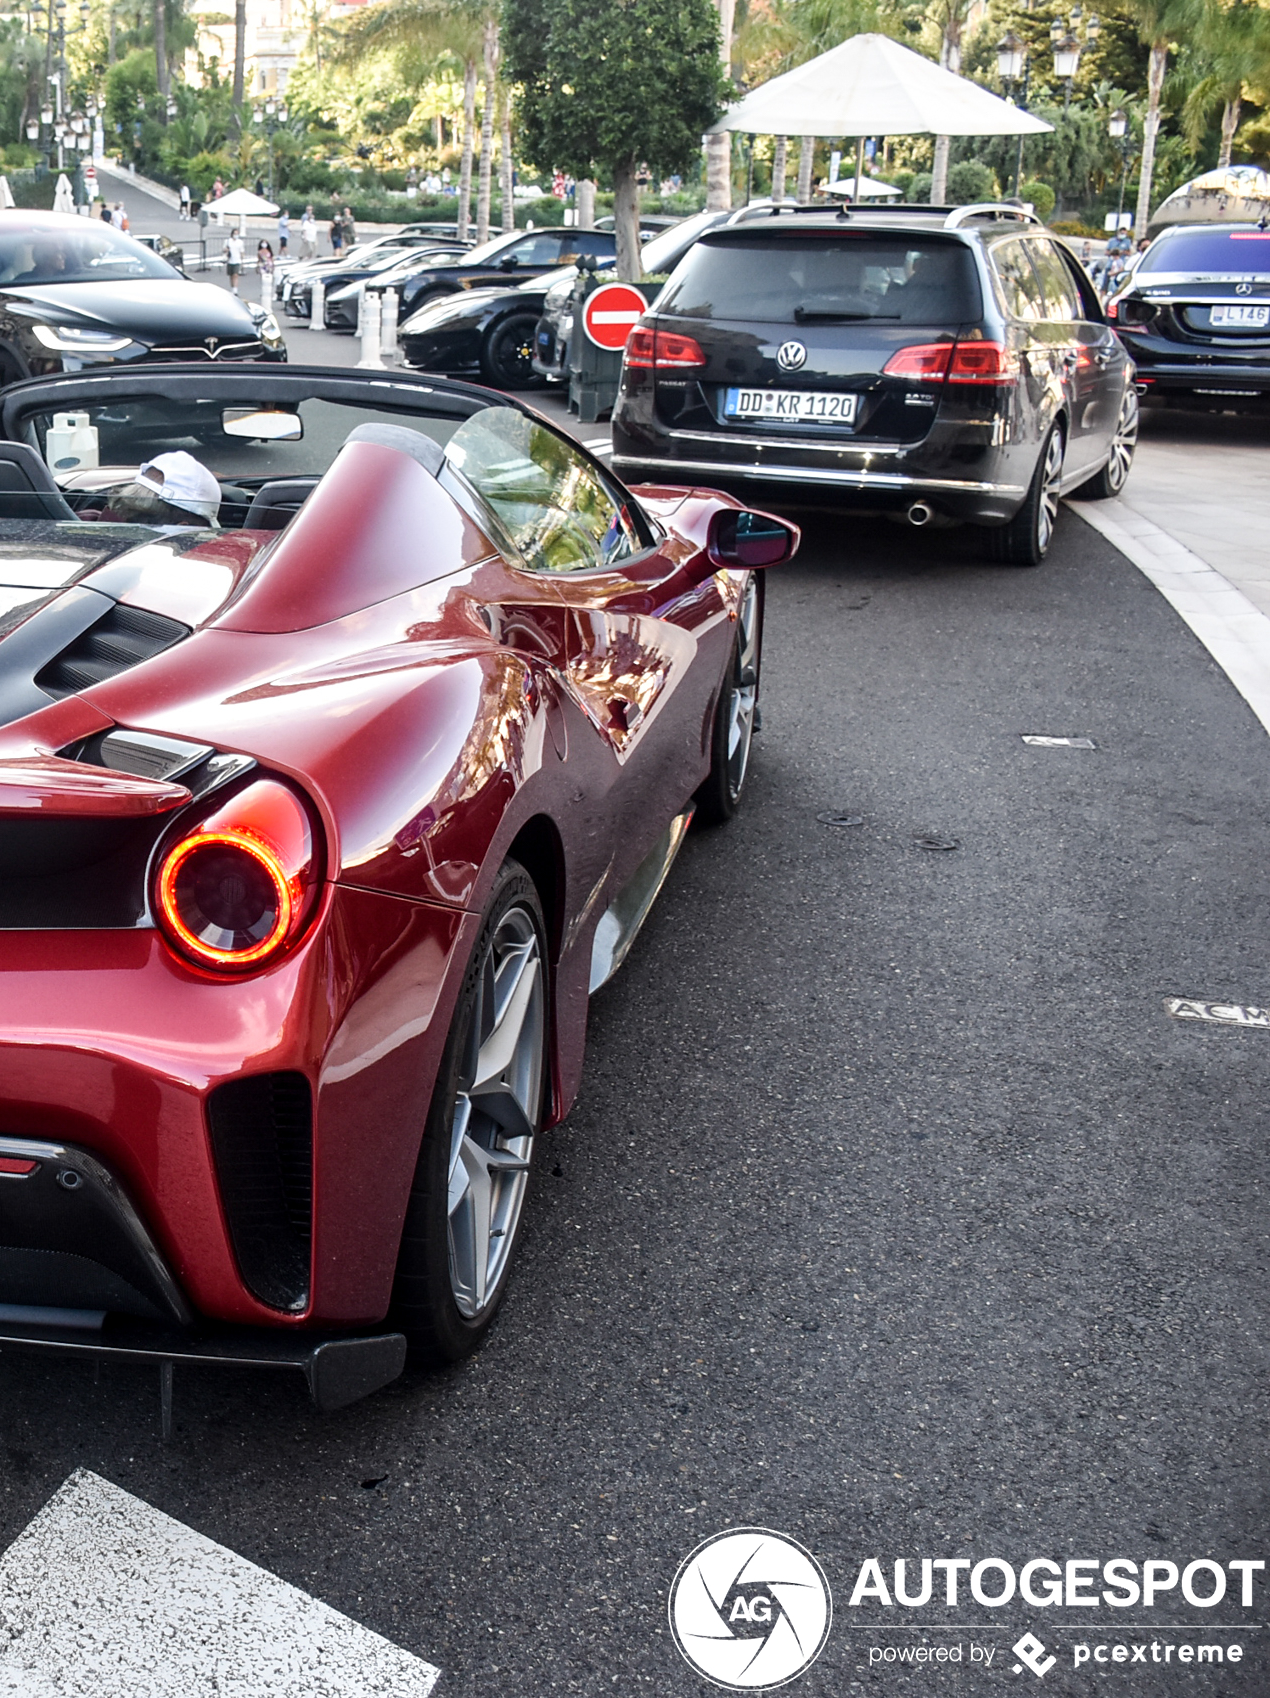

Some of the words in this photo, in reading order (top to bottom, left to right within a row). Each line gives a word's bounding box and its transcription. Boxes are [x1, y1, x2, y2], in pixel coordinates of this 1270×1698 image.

[738, 393, 763, 412] DD
[776, 395, 800, 415] KR
[804, 396, 852, 418] 1120
